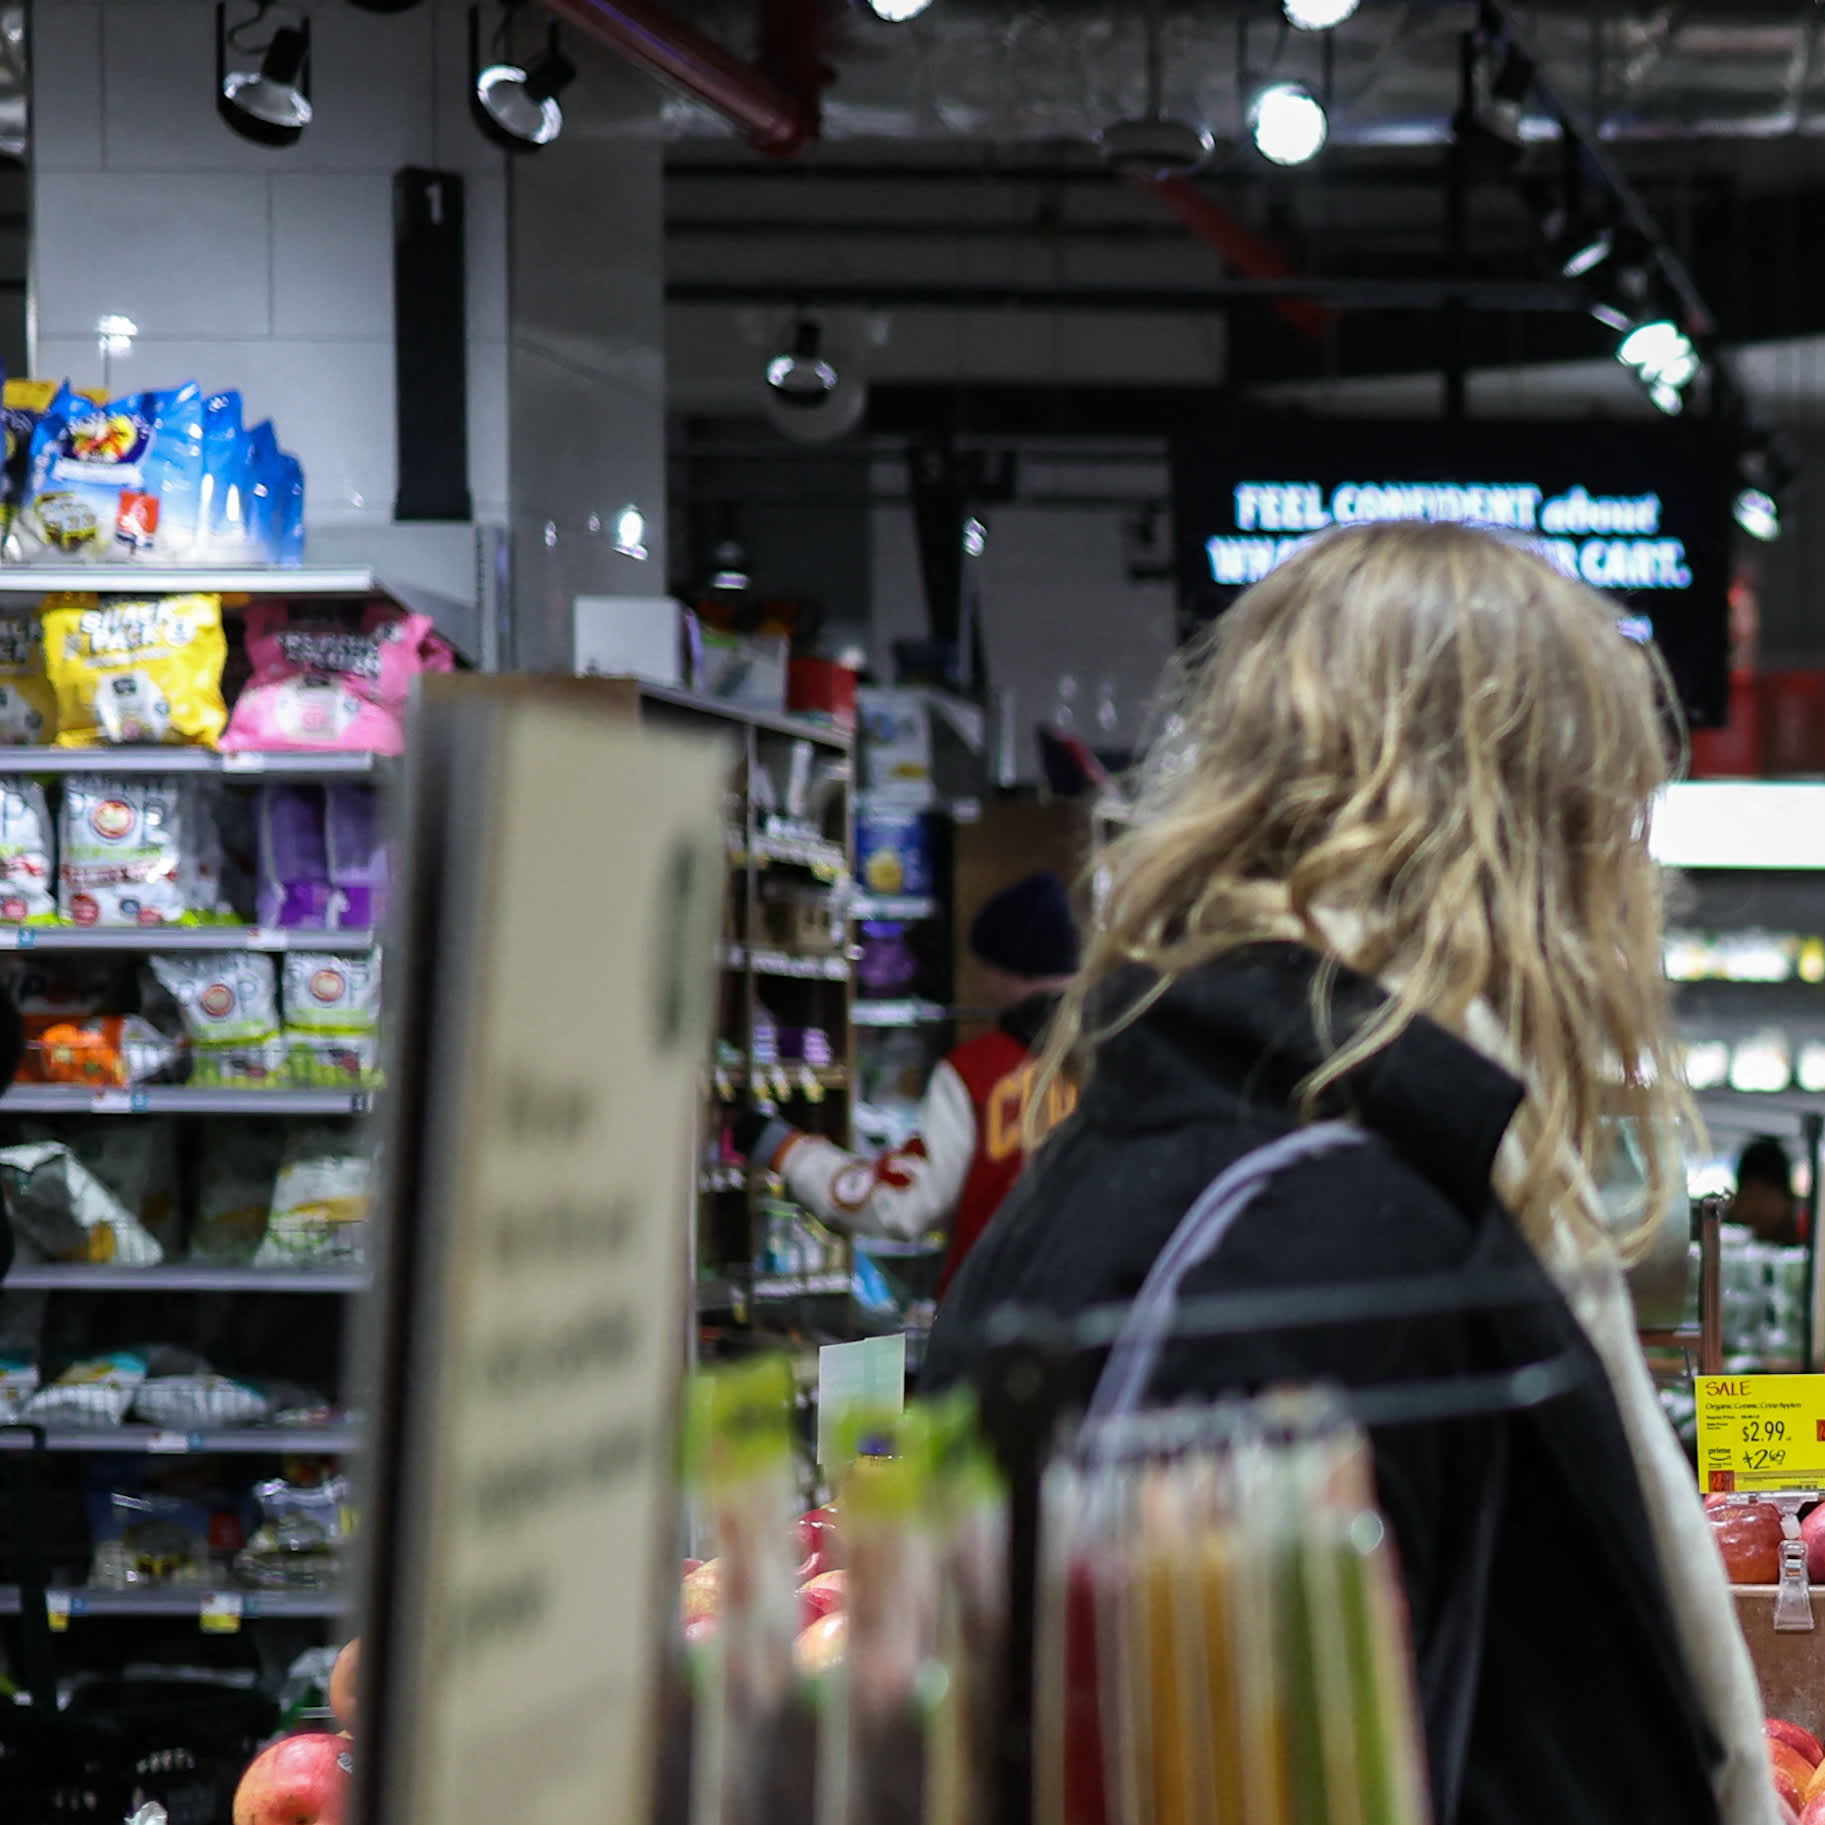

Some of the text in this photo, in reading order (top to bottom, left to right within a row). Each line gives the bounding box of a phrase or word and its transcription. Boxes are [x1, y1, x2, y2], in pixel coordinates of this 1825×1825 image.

[1233, 481, 1661, 534] FEEL CONFIDENT about
[1705, 1379, 1752, 1397] SALE
[1742, 1420, 1785, 1442] $2.99
